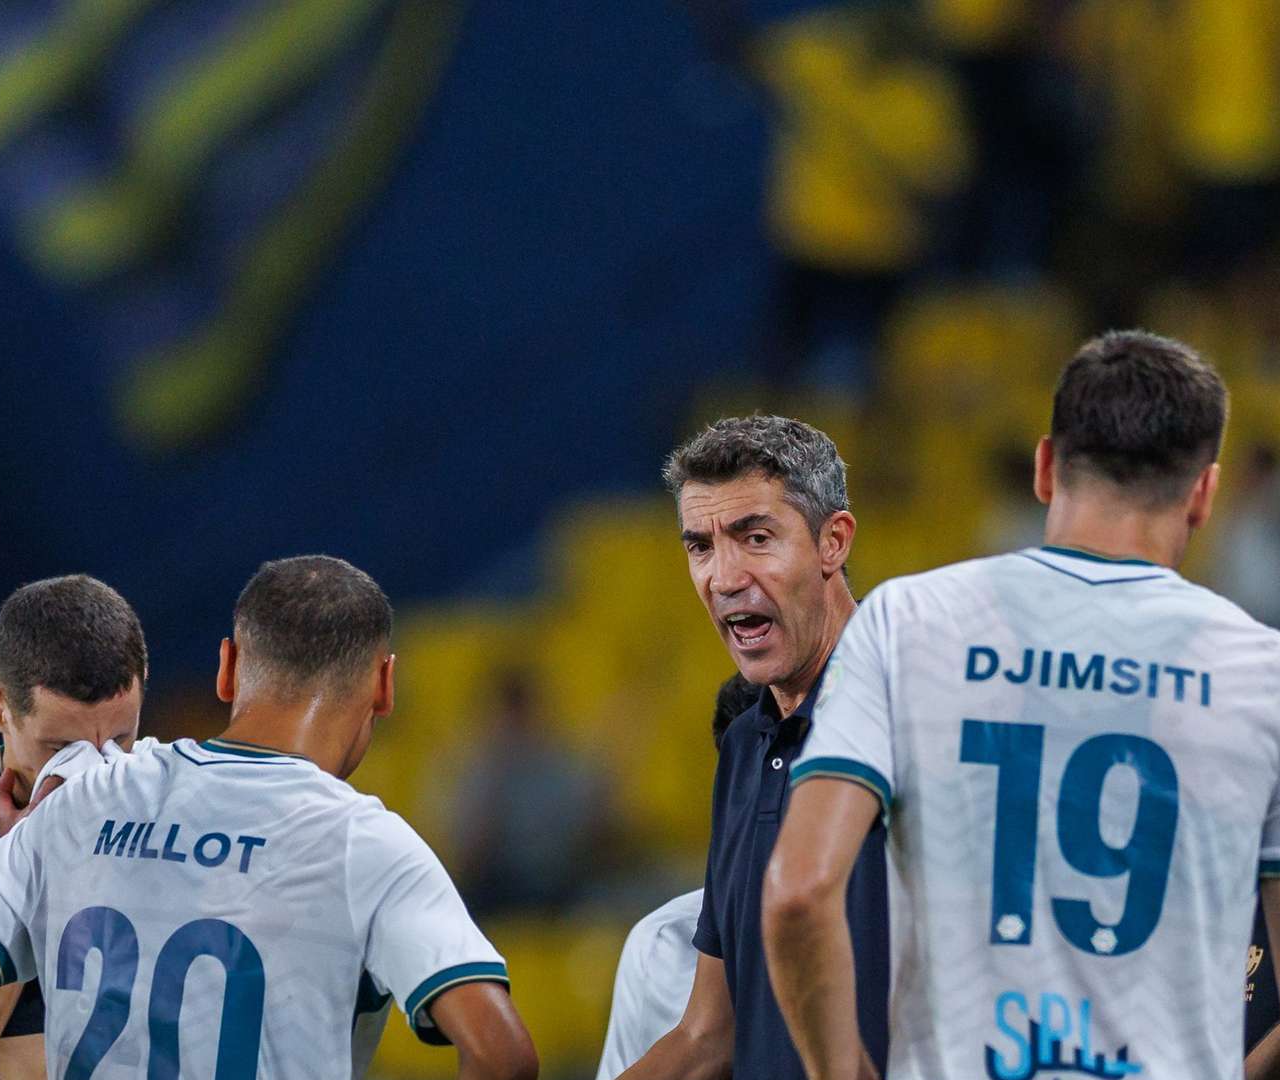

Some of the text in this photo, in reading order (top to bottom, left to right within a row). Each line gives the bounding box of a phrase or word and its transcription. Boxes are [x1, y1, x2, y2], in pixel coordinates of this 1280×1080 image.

[966, 645, 1212, 707] DJIMSITI
[93, 819, 266, 874] MILLOT
[960, 718, 1179, 957] 19
